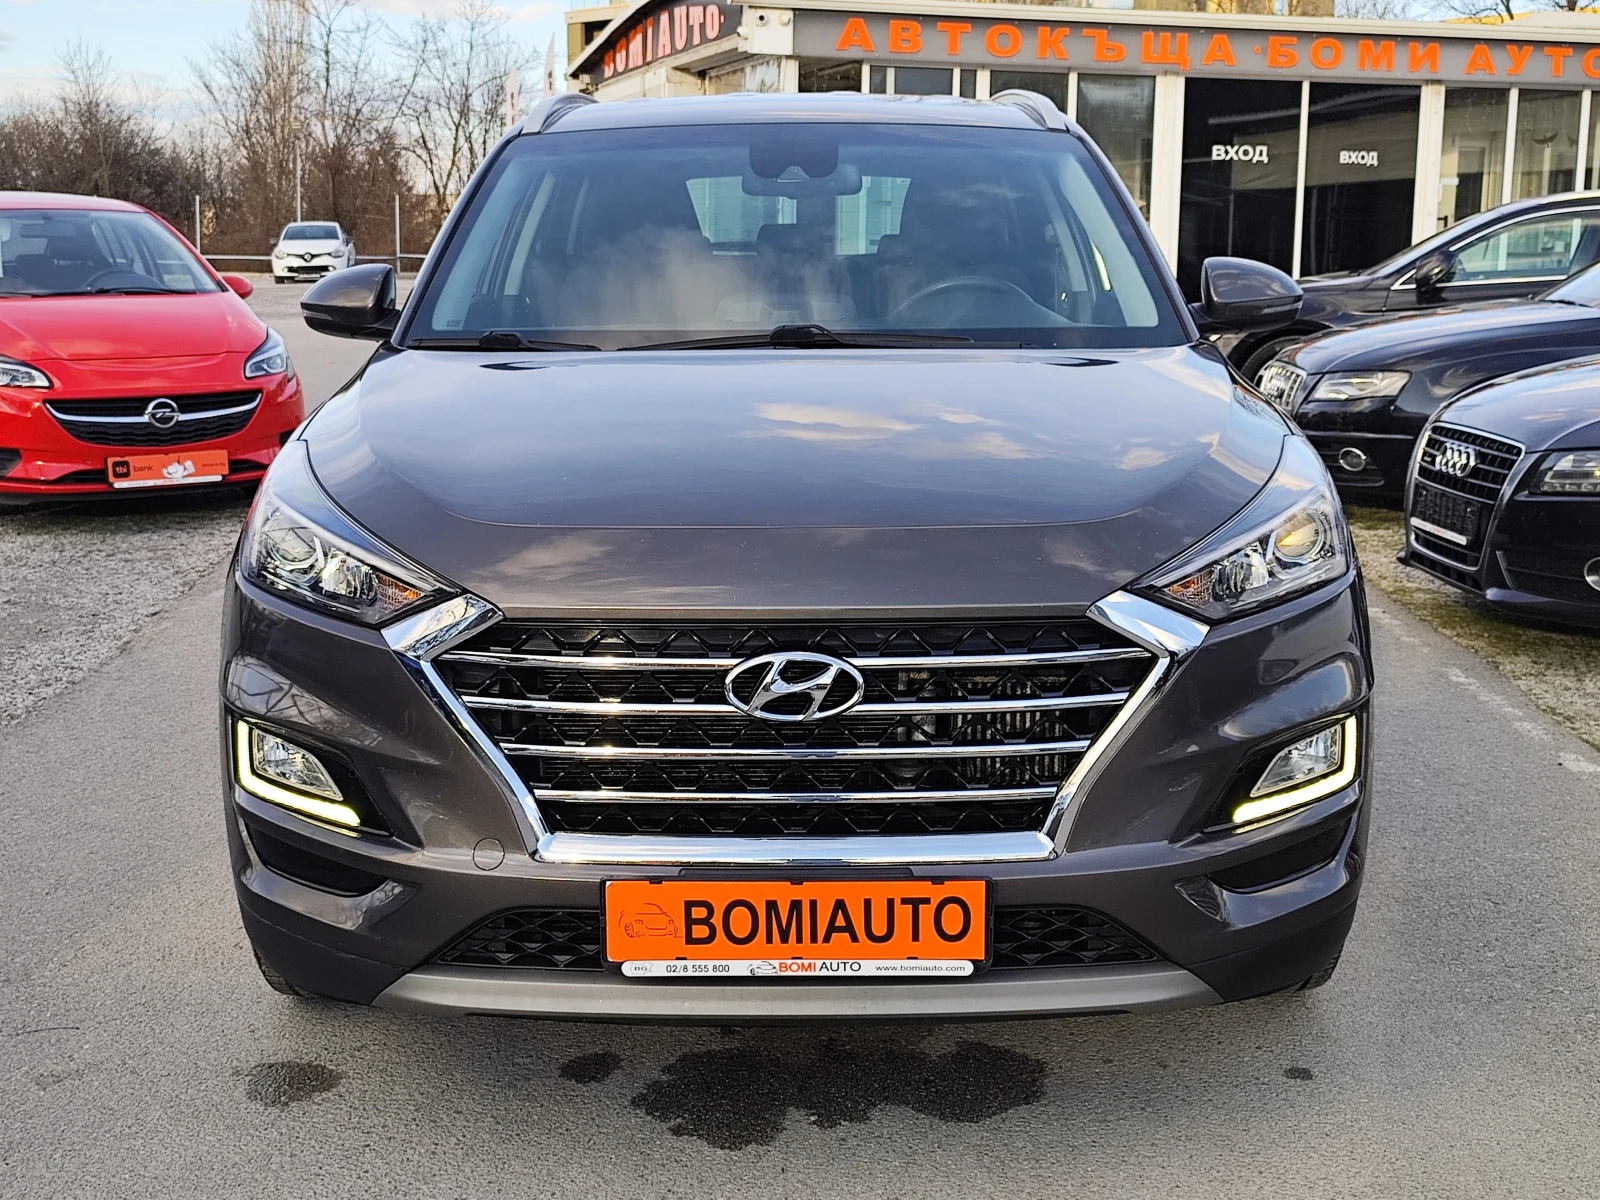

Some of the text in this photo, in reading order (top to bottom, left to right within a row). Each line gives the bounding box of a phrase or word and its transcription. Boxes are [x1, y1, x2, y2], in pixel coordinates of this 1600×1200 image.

[835, 17, 1237, 71] АВТОКЪЩА
[1267, 36, 1440, 74] БОМИ
[1211, 145, 1269, 164] ВХОД
[1339, 150, 1379, 167] ВХОД
[115, 464, 154, 474] tbi bank
[683, 897, 972, 946] BOMIAUTO
[665, 964, 730, 974] 02/8 555 800
[778, 961, 862, 973] BOMI AUTO
